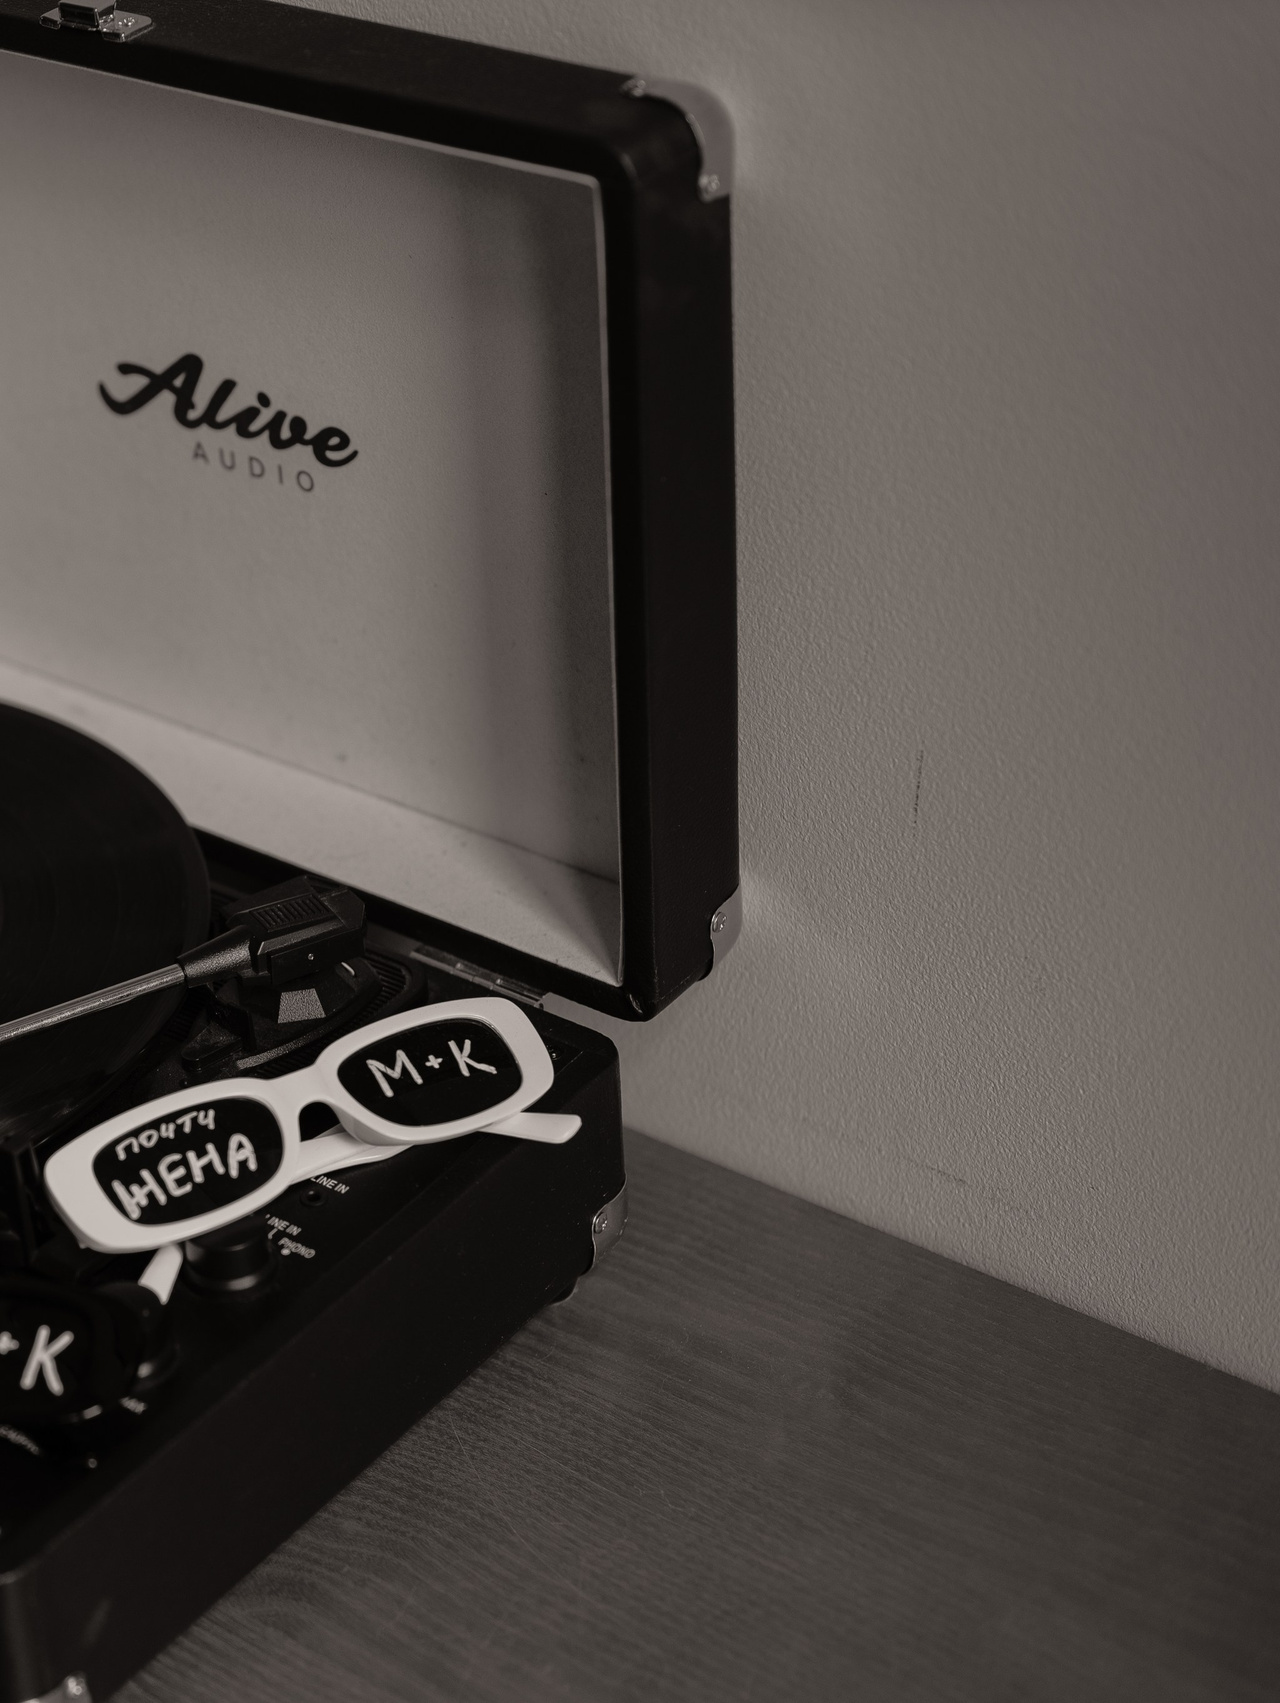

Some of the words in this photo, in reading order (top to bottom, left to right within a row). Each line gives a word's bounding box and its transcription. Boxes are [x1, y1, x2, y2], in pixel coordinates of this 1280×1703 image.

[98, 352, 360, 468] Alive
[192, 440, 315, 493] AUDIO
[111, 1132, 259, 1220] ЖЕНА
[333, 1182, 350, 1195] IN
[277, 1237, 316, 1259] PHONO
[285, 1224, 302, 1237] IN
